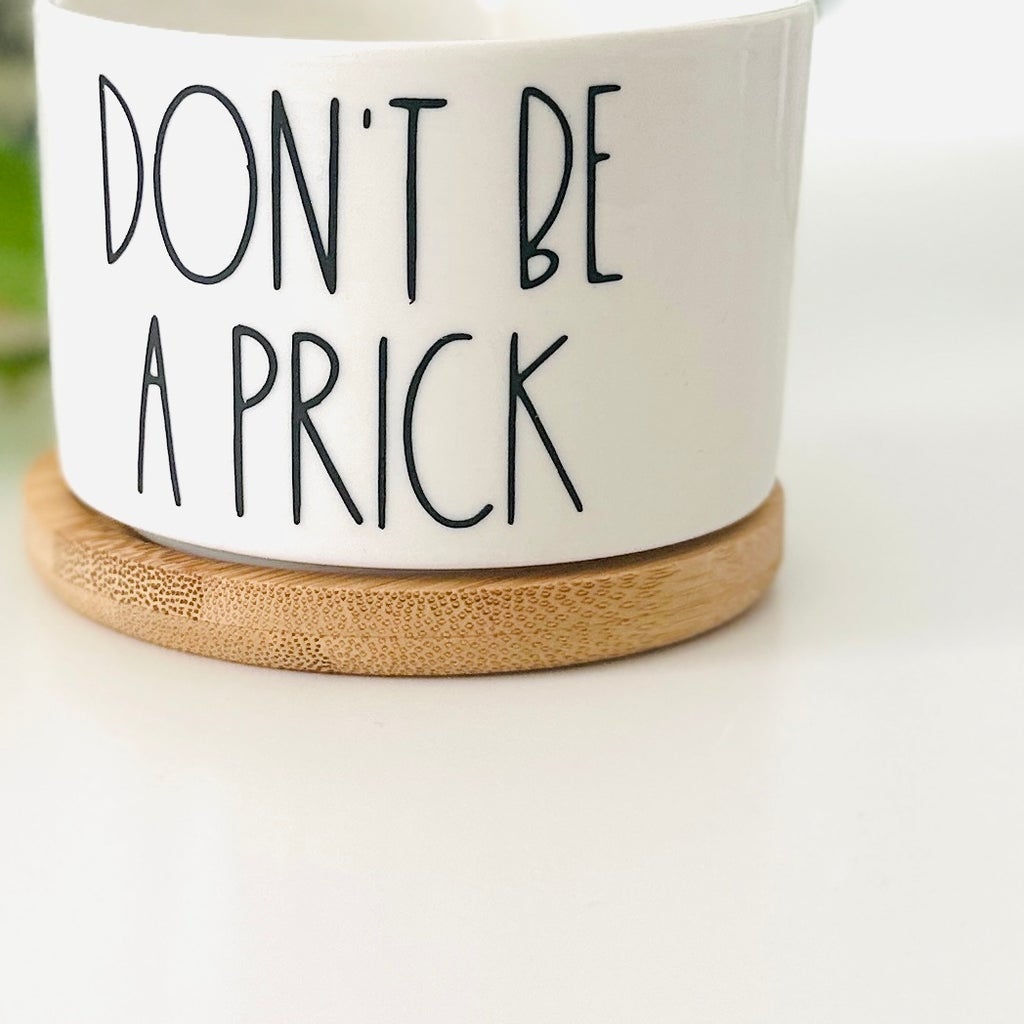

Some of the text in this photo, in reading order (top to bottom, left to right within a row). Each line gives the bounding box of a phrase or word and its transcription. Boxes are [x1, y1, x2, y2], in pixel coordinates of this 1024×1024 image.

[99, 74, 623, 304] DON'T BE
[137, 315, 583, 529] A PRICK
